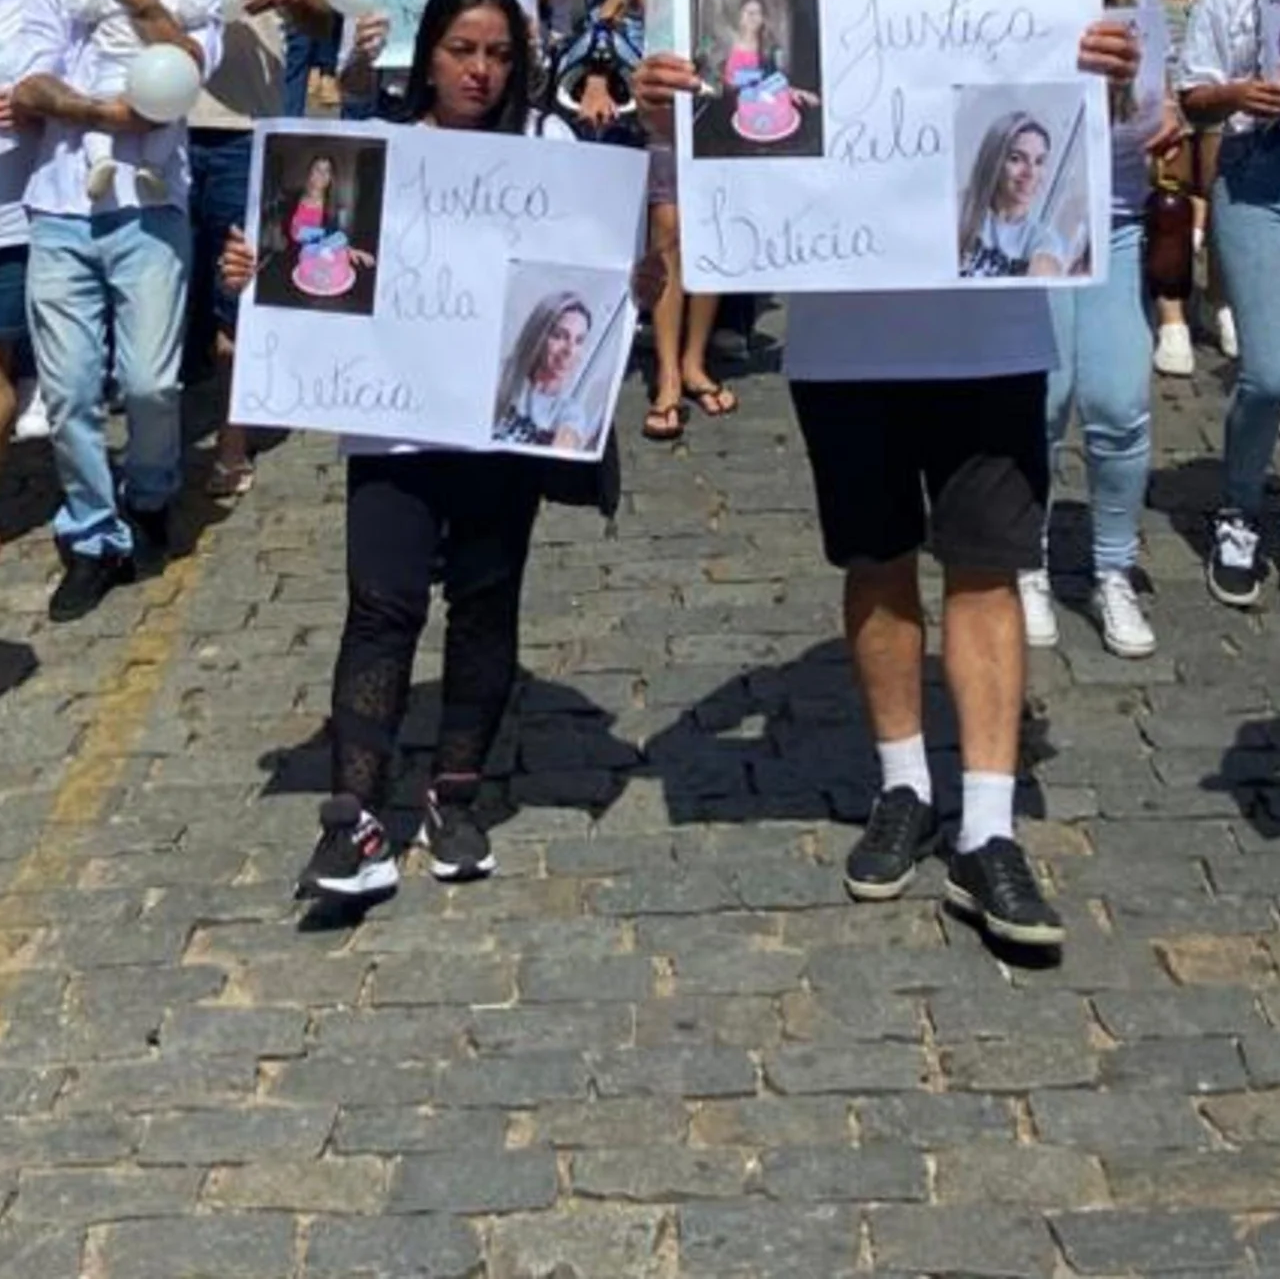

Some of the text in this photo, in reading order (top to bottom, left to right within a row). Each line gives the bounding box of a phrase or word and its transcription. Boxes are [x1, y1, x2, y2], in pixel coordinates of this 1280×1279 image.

[829, 86, 943, 167] Pela
[396, 157, 562, 267] Justiça
[381, 266, 481, 321] Pela
